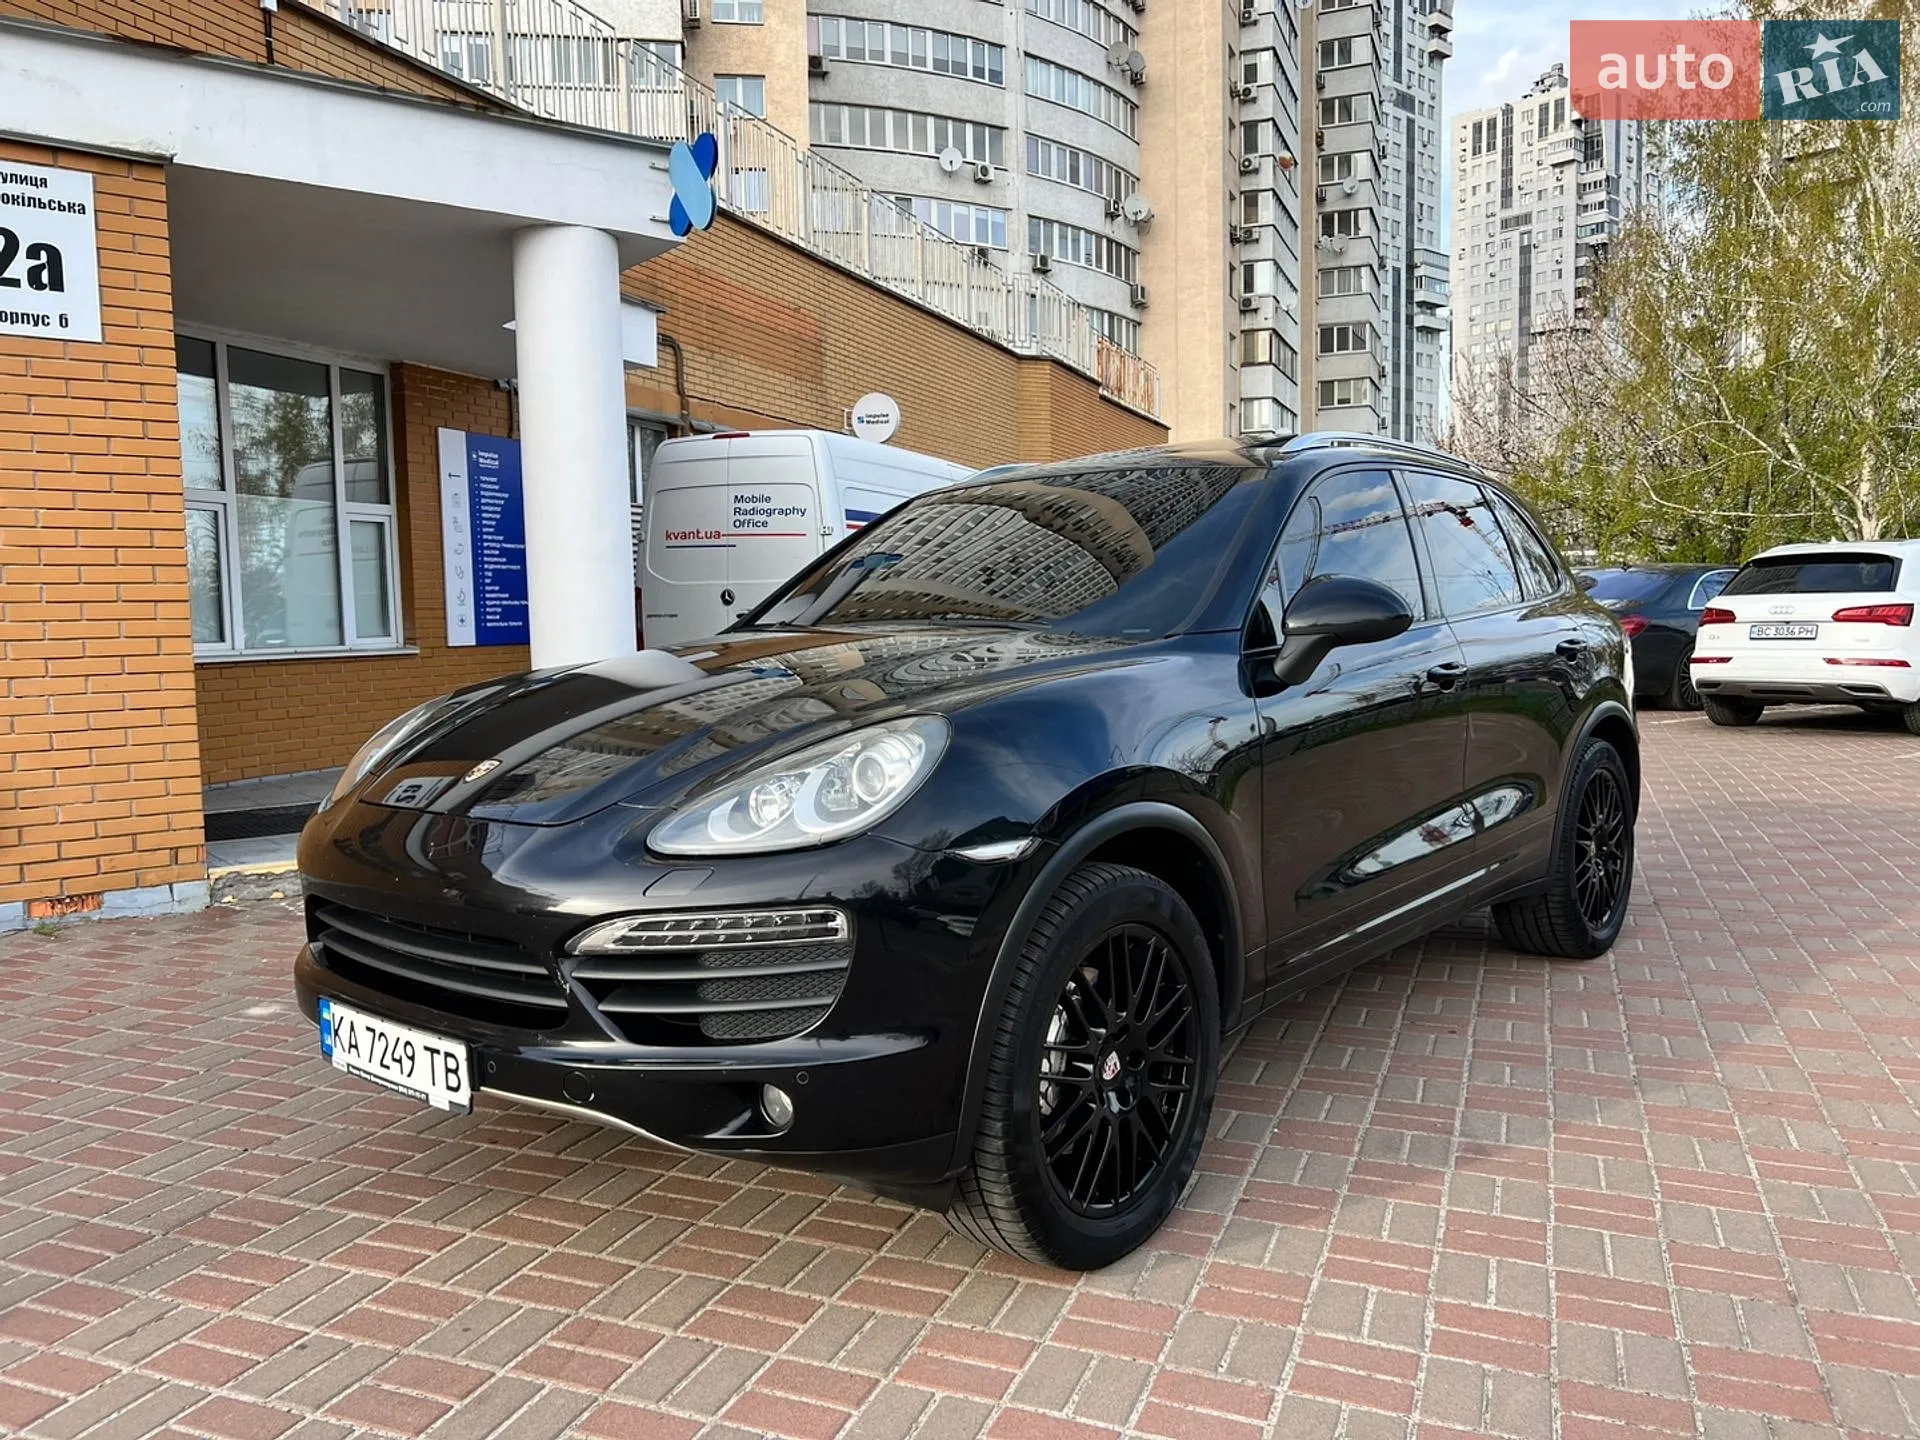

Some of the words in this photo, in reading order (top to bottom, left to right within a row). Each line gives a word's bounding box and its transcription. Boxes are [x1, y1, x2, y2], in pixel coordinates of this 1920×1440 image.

[733, 494, 771, 504] Mobile
[733, 506, 807, 517] Radiography
[733, 519, 768, 529] Office
[665, 528, 721, 541] kvant.ua
[1757, 627, 1771, 636] BC
[1773, 627, 1796, 636] 3036
[331, 1012, 361, 1058] KA
[365, 1026, 415, 1078] 7249
[423, 1044, 461, 1093] TB
